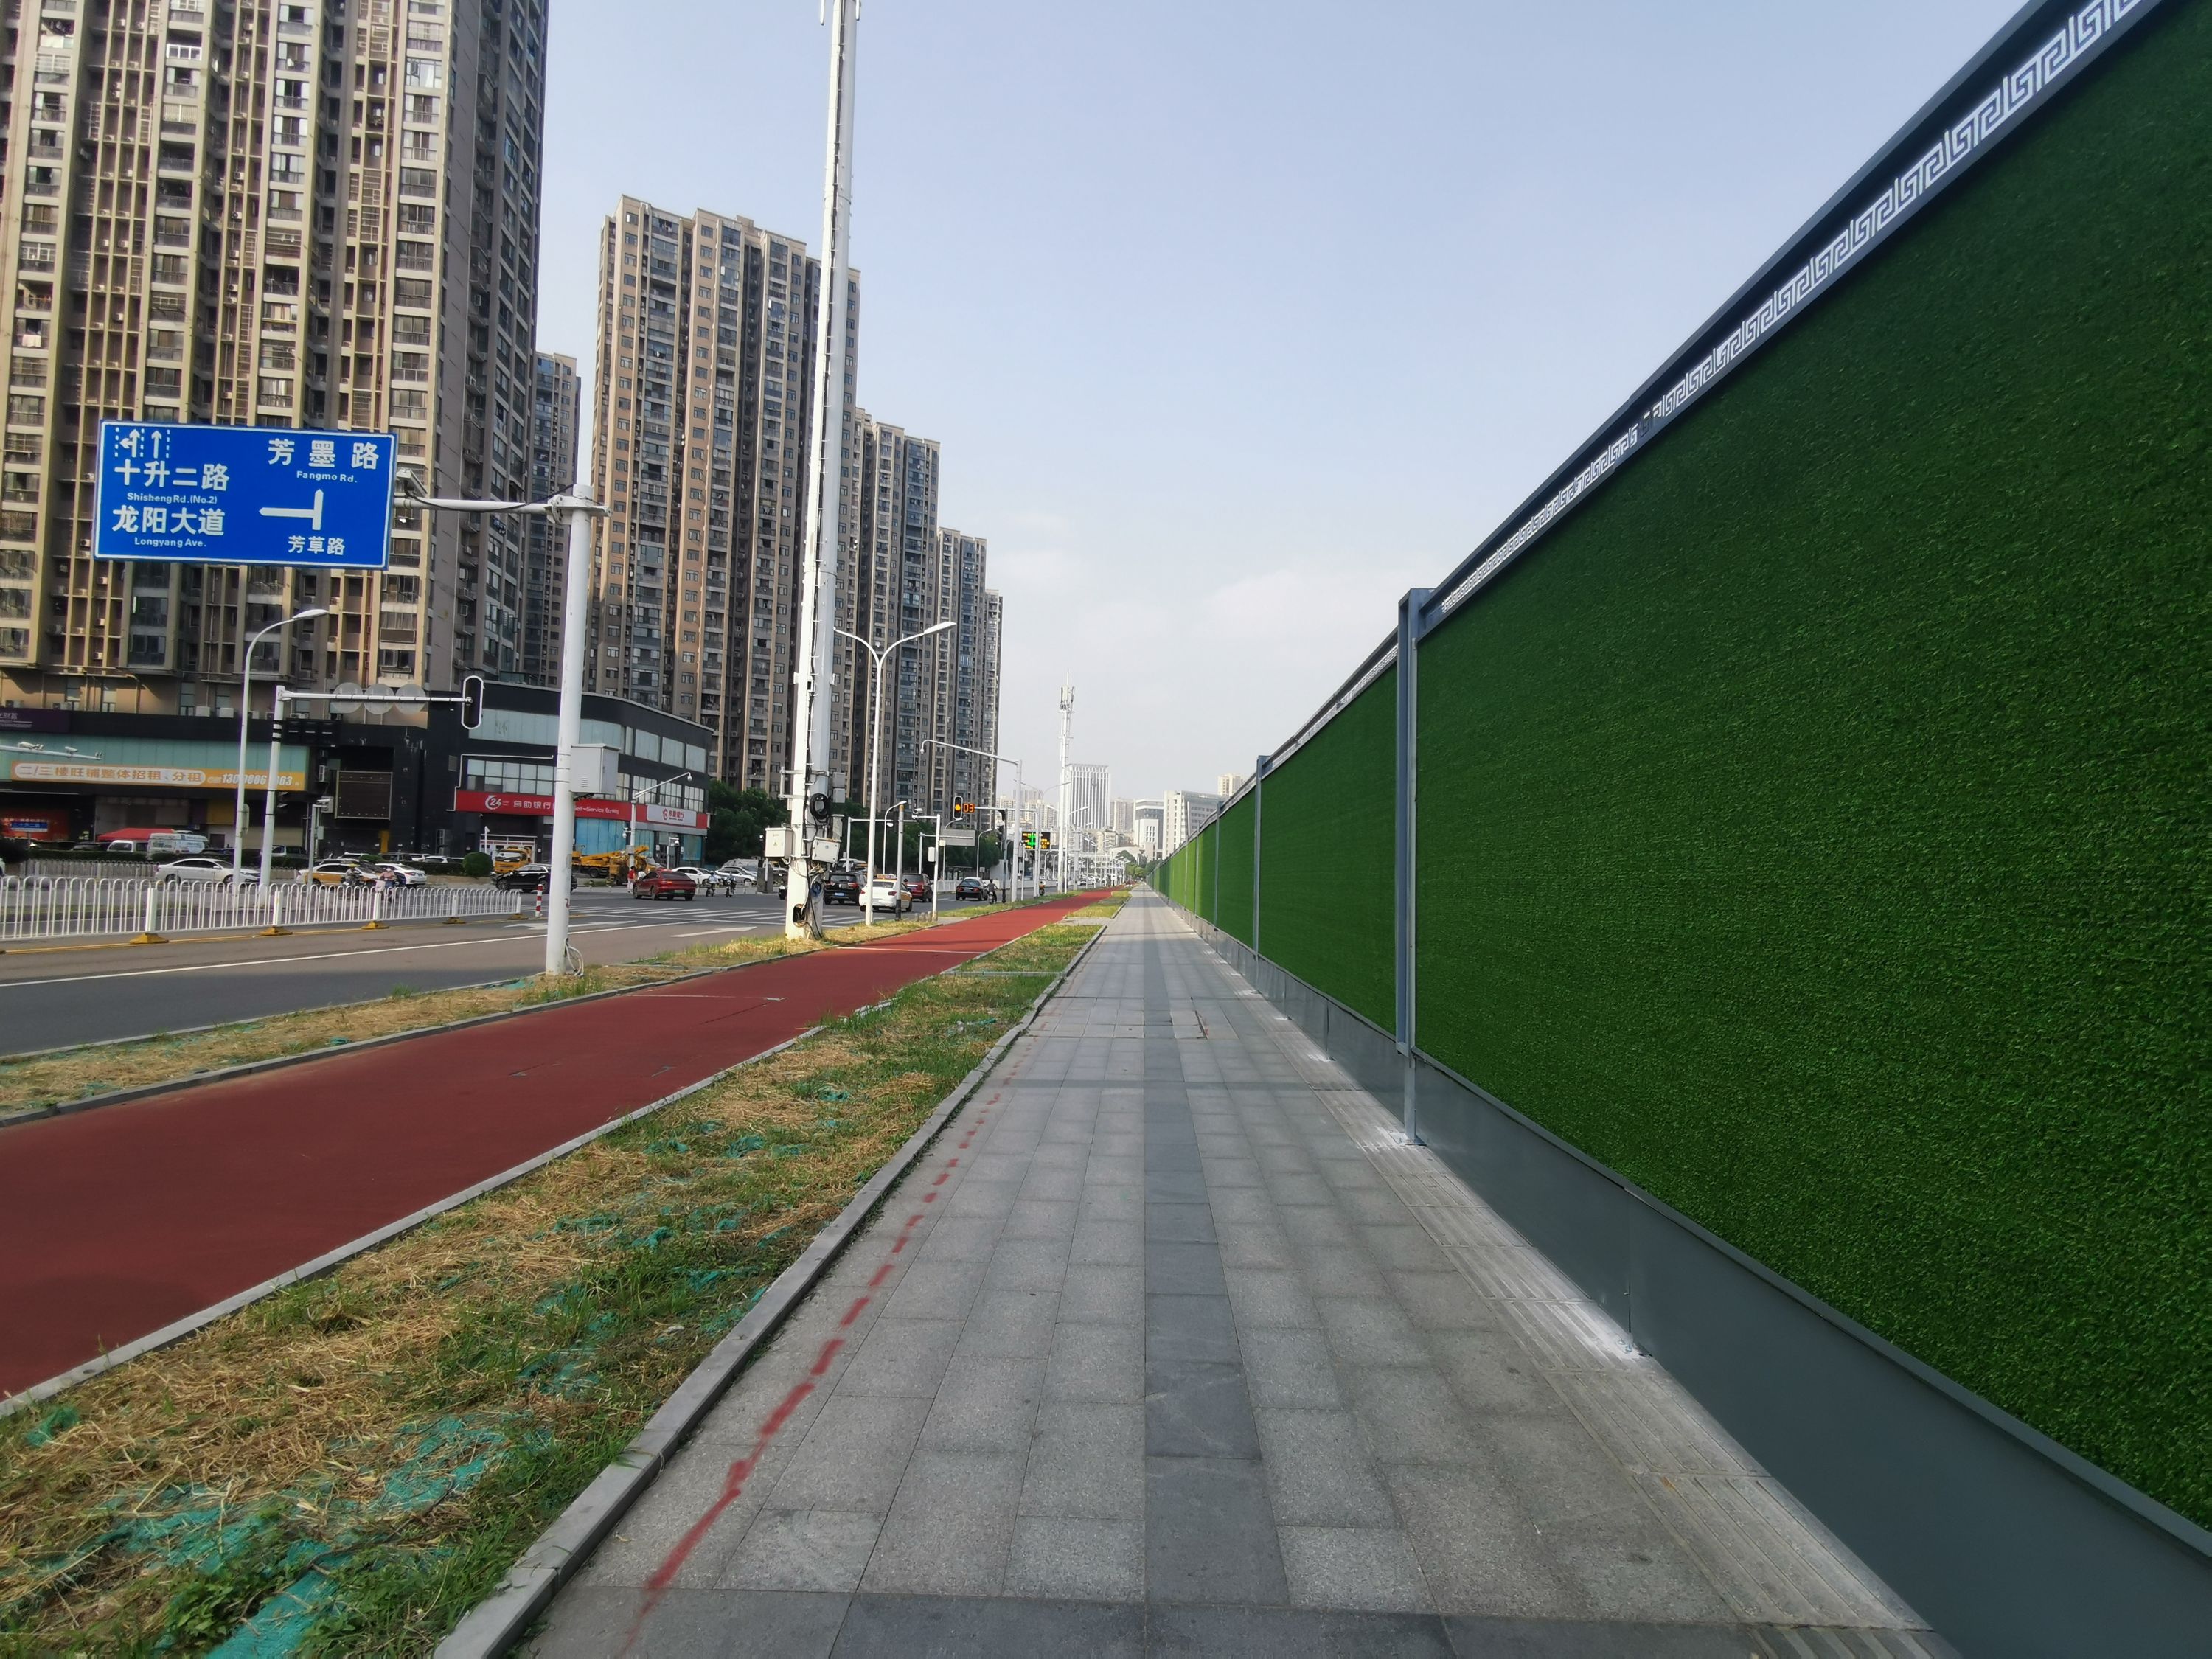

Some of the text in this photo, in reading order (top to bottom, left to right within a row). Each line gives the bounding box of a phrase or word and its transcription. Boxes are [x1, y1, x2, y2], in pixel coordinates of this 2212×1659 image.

[268, 438, 379, 470] 芳墨路
[114, 458, 230, 491] 十升二路
[296, 470, 358, 483] Fangmo Rd.
[127, 492, 172, 504] Shisheng
[112, 504, 226, 536] 龙阳大道
[134, 537, 207, 548] Longyang Ave.
[288, 535, 345, 556] 芳草路
[963, 803, 974, 813] 03
